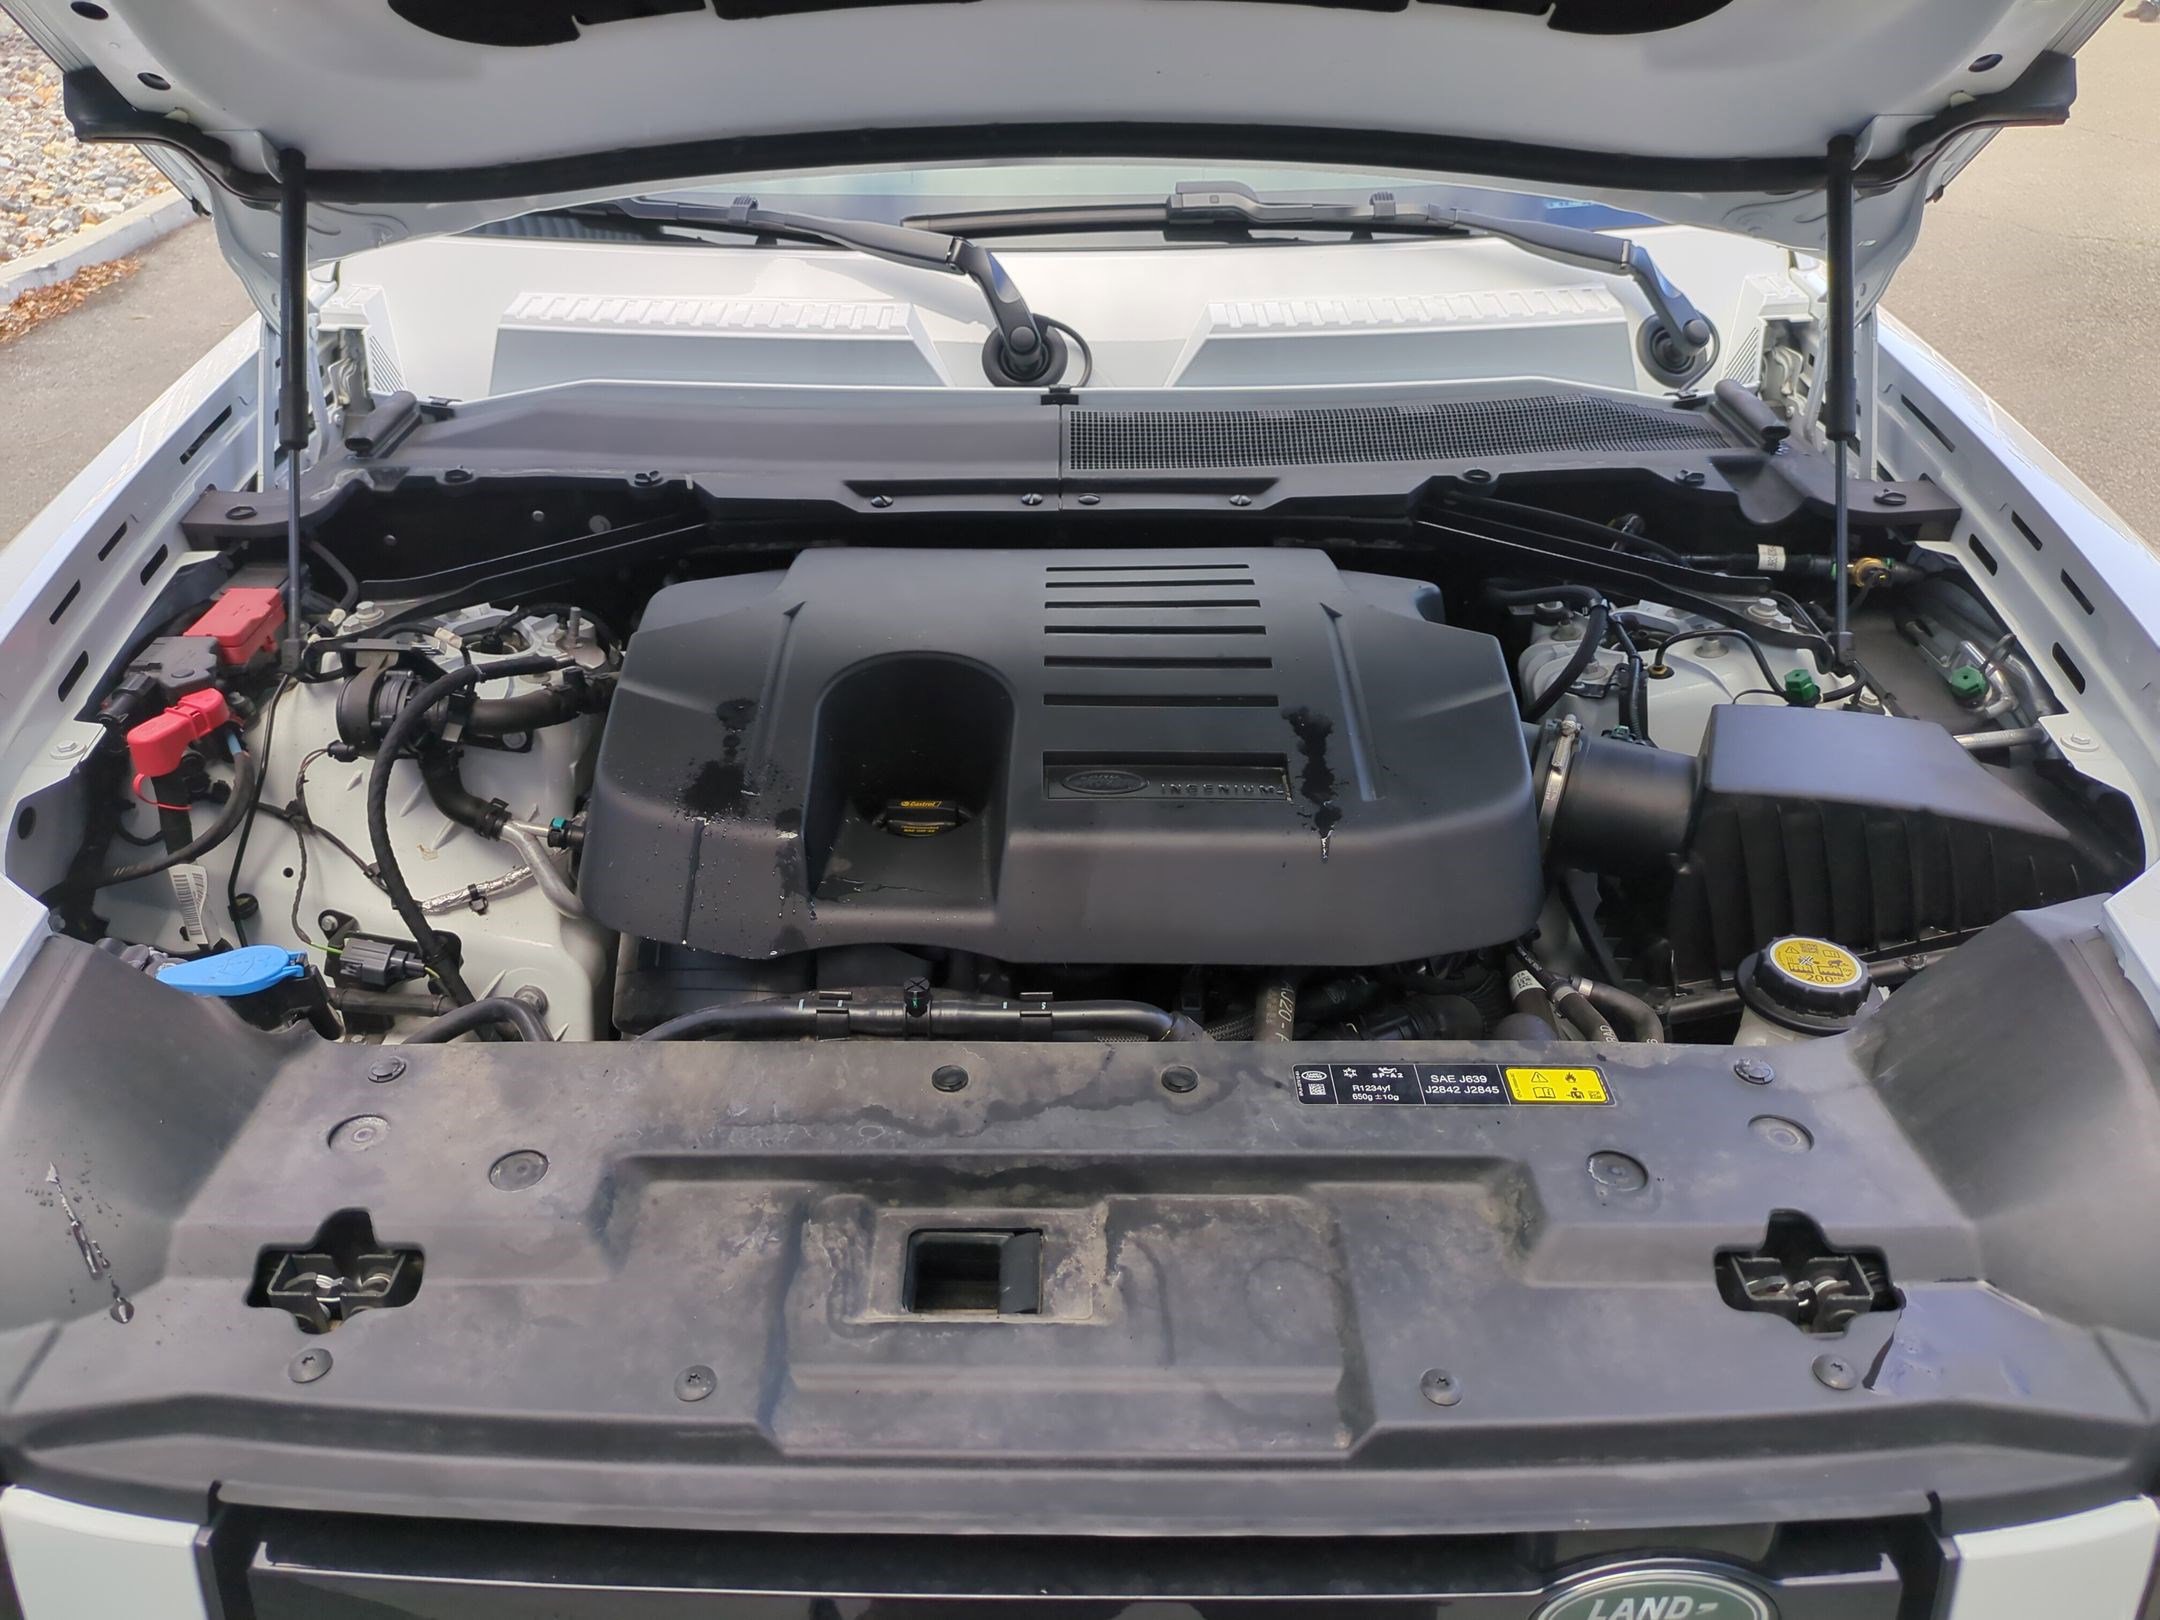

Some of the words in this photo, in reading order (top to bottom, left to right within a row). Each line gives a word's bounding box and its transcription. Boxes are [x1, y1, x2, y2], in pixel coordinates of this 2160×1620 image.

[1160, 783, 1276, 795] INGENIUM
[1430, 1074, 1456, 1083] SAE
[1458, 1074, 1487, 1083] J639
[1351, 1084, 1391, 1093] R1234yf
[1425, 1085, 1461, 1094] J2842
[1463, 1085, 1500, 1095] J2845
[1352, 1093, 1374, 1101] 650g
